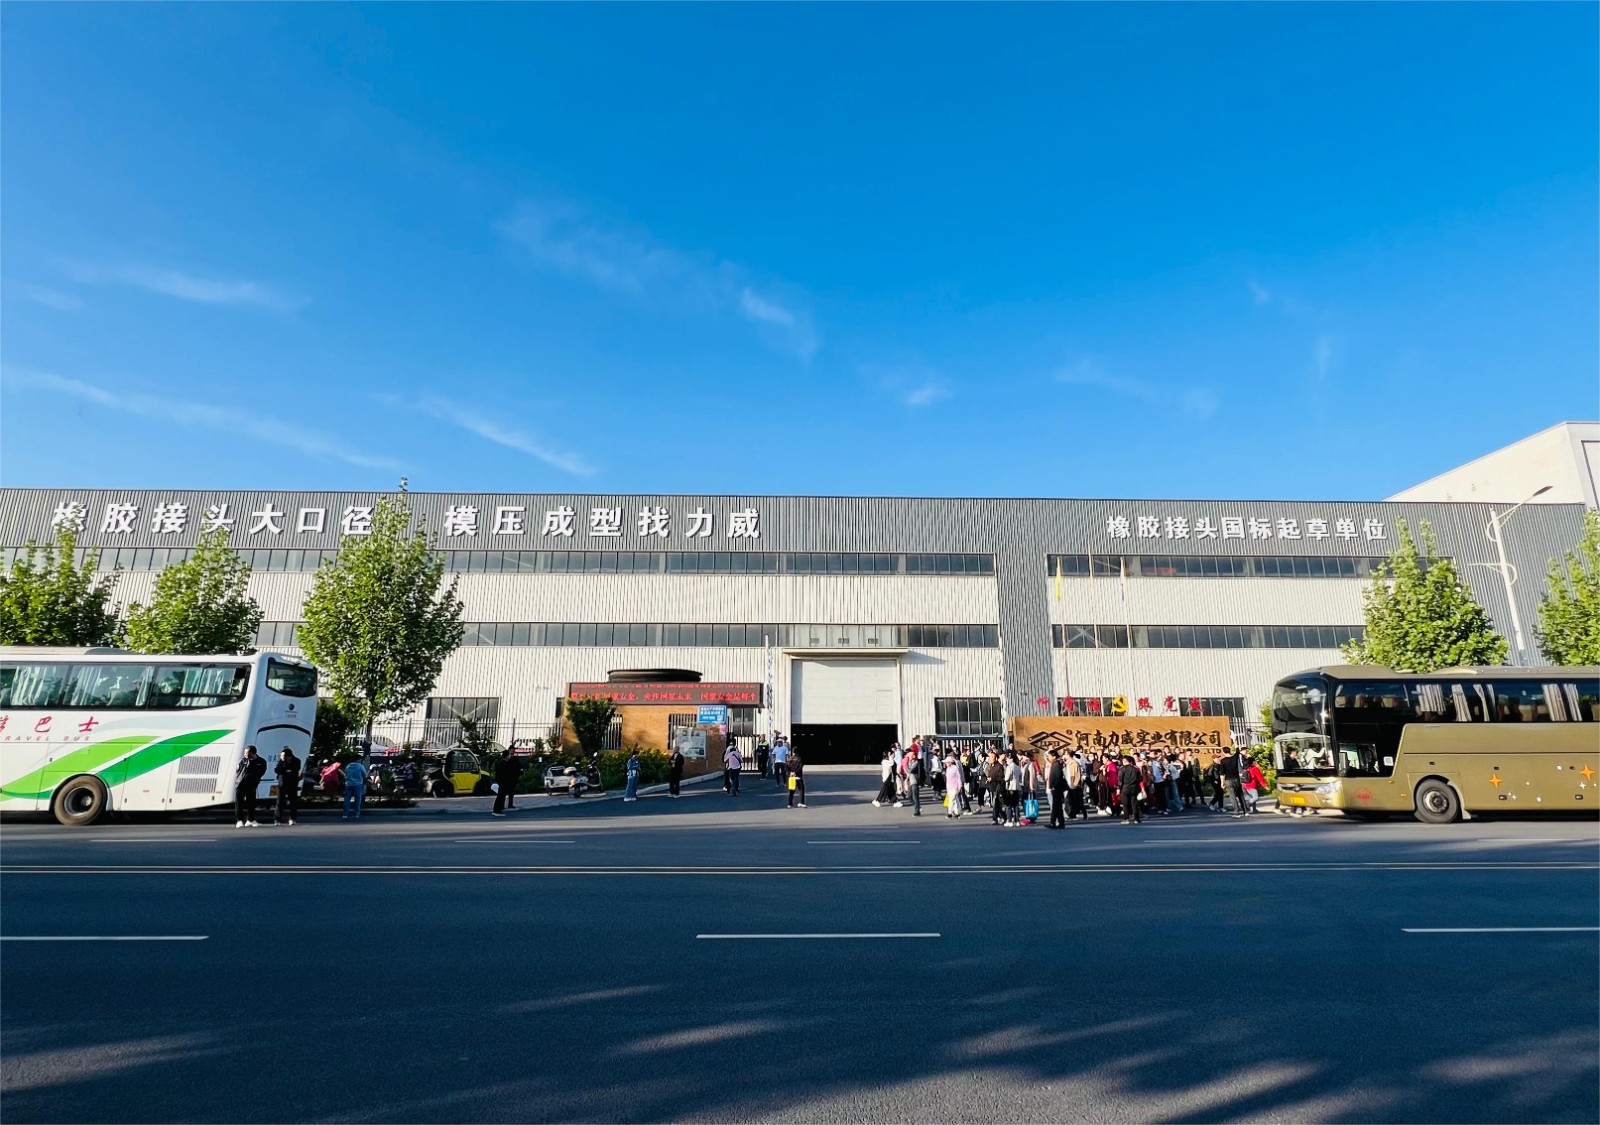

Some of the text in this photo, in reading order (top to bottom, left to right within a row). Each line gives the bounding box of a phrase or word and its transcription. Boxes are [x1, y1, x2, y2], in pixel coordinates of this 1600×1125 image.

[51, 501, 761, 538] 橡胶接头大口径 模压成型找力威
[1106, 515, 1387, 541] 橡胶接头国标起草单位
[1075, 729, 1221, 748] 河南力威实业有限公司
